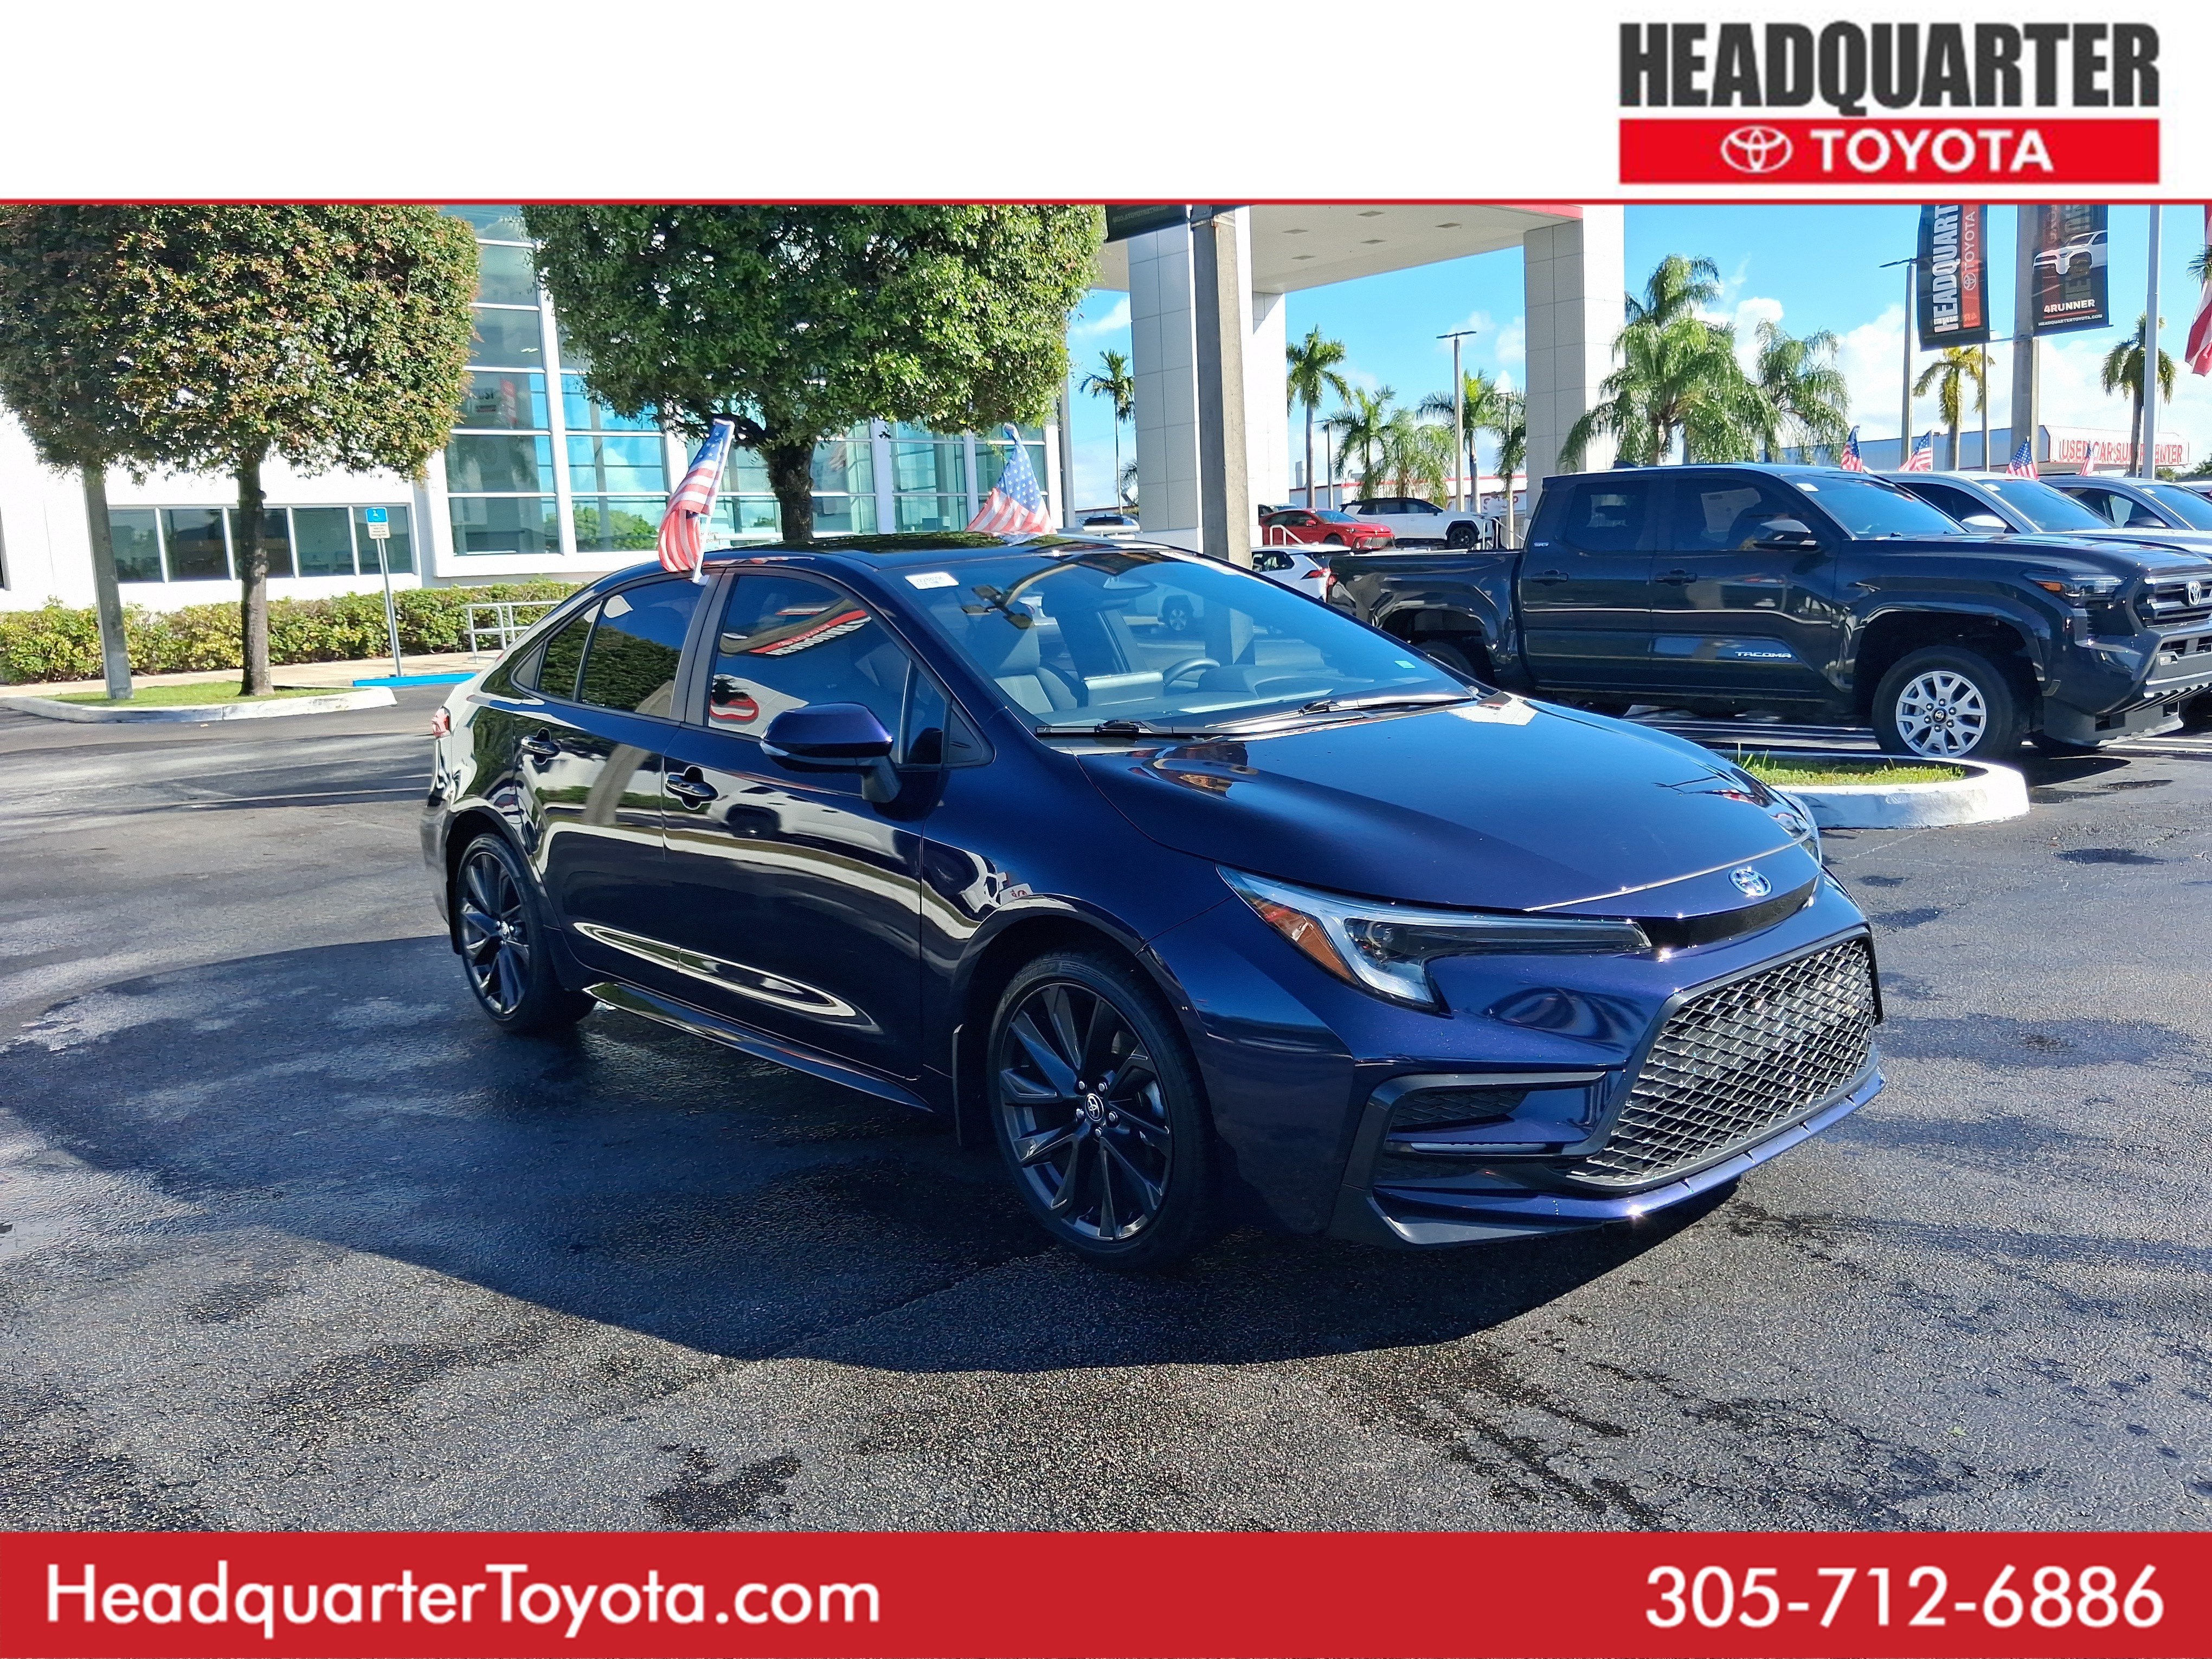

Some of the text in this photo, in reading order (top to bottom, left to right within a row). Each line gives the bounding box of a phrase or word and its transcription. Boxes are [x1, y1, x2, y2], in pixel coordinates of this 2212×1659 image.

[1964, 211, 1975, 272] TOYOTA
[2043, 299, 2095, 313] 4RUNNER
[2093, 441, 2113, 461] CAR
